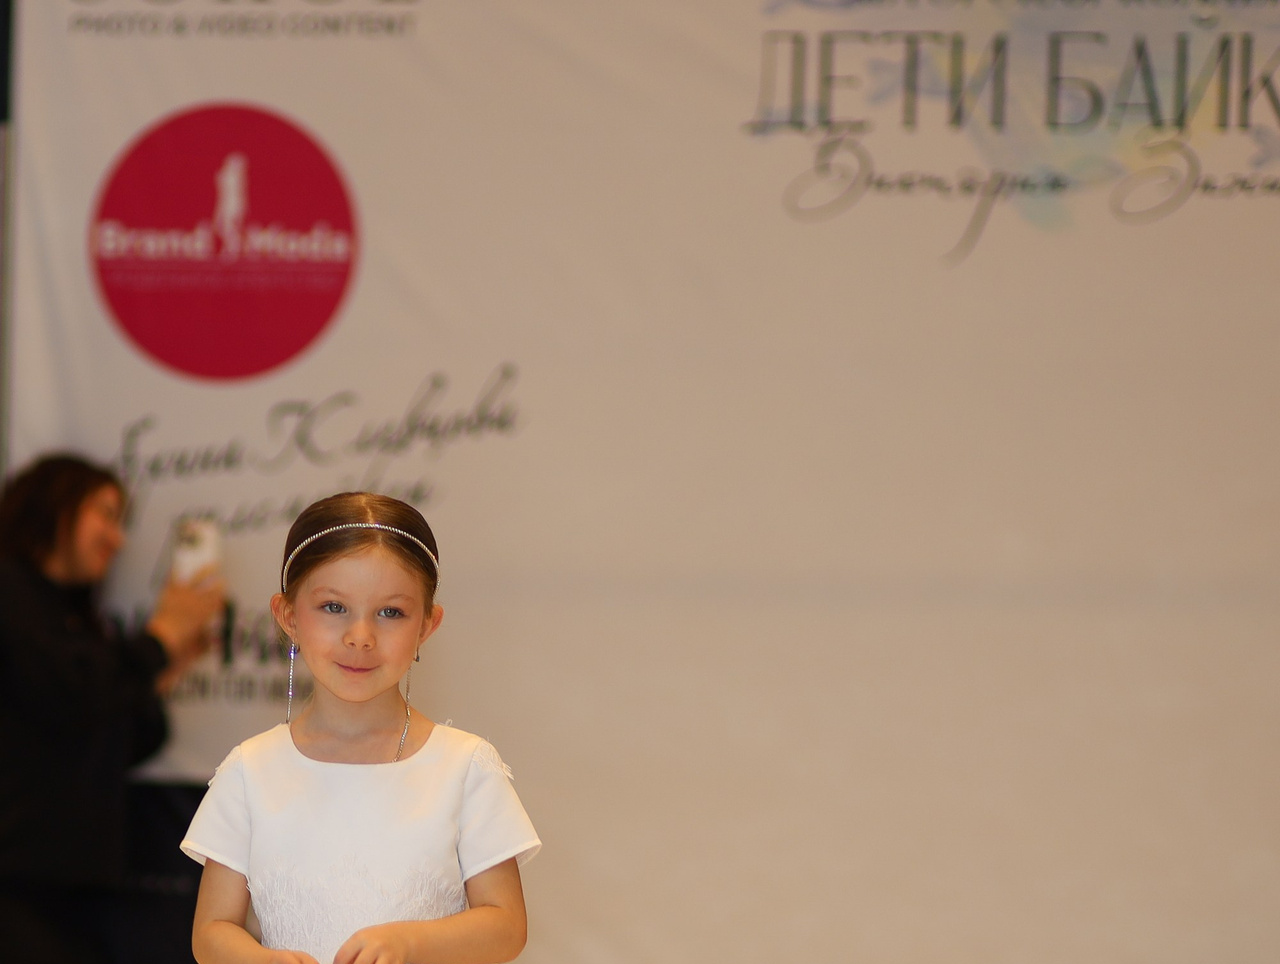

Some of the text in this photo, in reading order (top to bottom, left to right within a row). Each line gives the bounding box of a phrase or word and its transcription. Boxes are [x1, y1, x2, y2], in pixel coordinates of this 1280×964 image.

[70, 12, 417, 39] PHOTO & VIDEO CONTENT
[742, 30, 1008, 134] ДЕТИ
[98, 222, 211, 257] Brand
